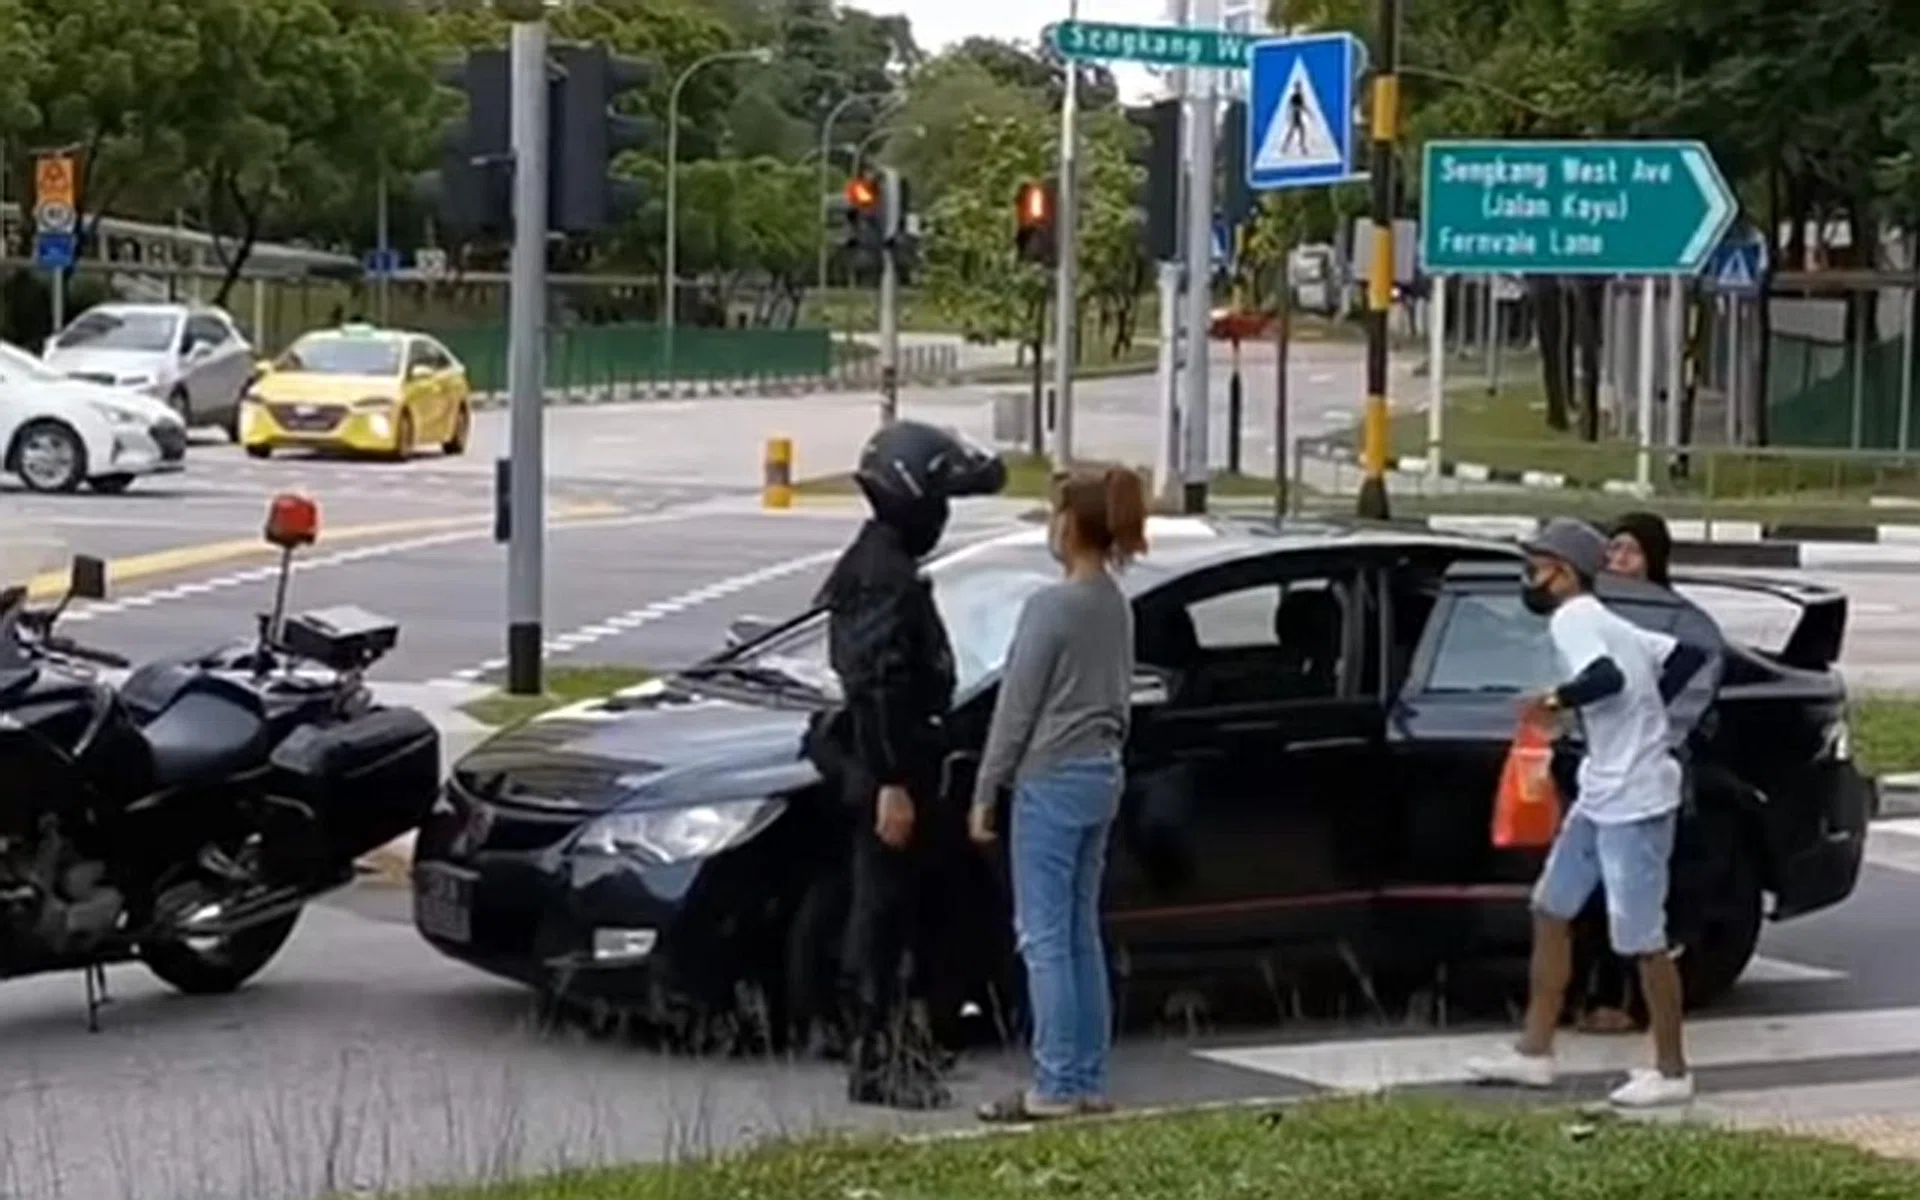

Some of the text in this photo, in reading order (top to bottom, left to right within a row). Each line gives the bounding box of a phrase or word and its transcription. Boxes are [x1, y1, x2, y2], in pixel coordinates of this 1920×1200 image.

[1069, 26, 1202, 62] Sengkang
[1440, 154, 1671, 189] Sengkang West Ave
[1482, 191, 1628, 227] (Jalan Kayu)
[1438, 226, 1603, 255] Fernvale Lane
